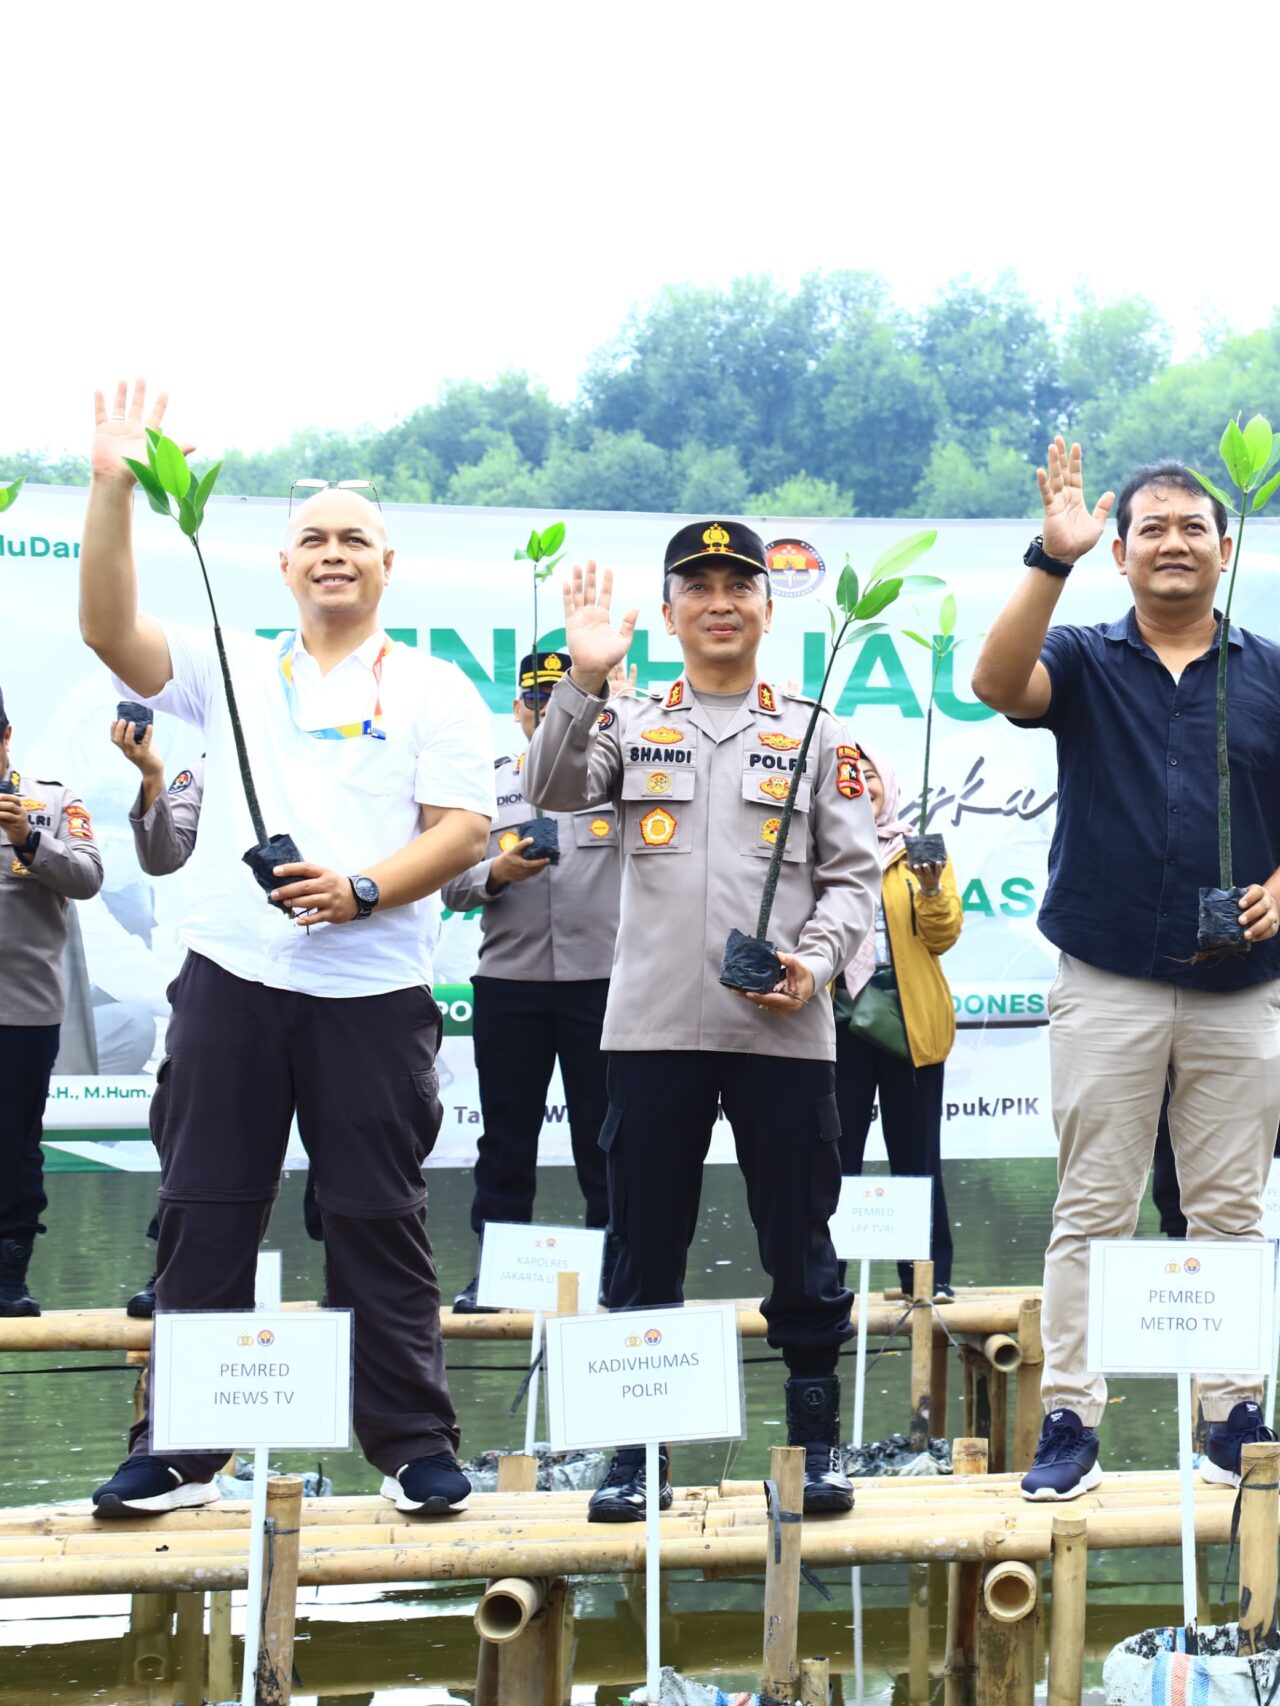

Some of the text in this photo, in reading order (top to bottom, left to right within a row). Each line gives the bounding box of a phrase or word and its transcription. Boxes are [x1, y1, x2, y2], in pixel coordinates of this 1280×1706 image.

[629, 746, 692, 764] SHANDI
[84, 1086, 152, 1099] M.Hum.
[940, 1096, 1041, 1122] puk/PIK
[851, 1207, 895, 1218] PEMRED
[517, 1256, 569, 1270] KAPOLRES
[500, 1271, 544, 1283] JAKARTA
[1149, 1289, 1216, 1305] PEMRED
[1140, 1316, 1223, 1332] METRO TV
[220, 1363, 290, 1377] PEMRED
[588, 1352, 700, 1375] KADIVHUMAS
[214, 1391, 294, 1405] INEWS TV
[622, 1382, 668, 1399] POLRI
